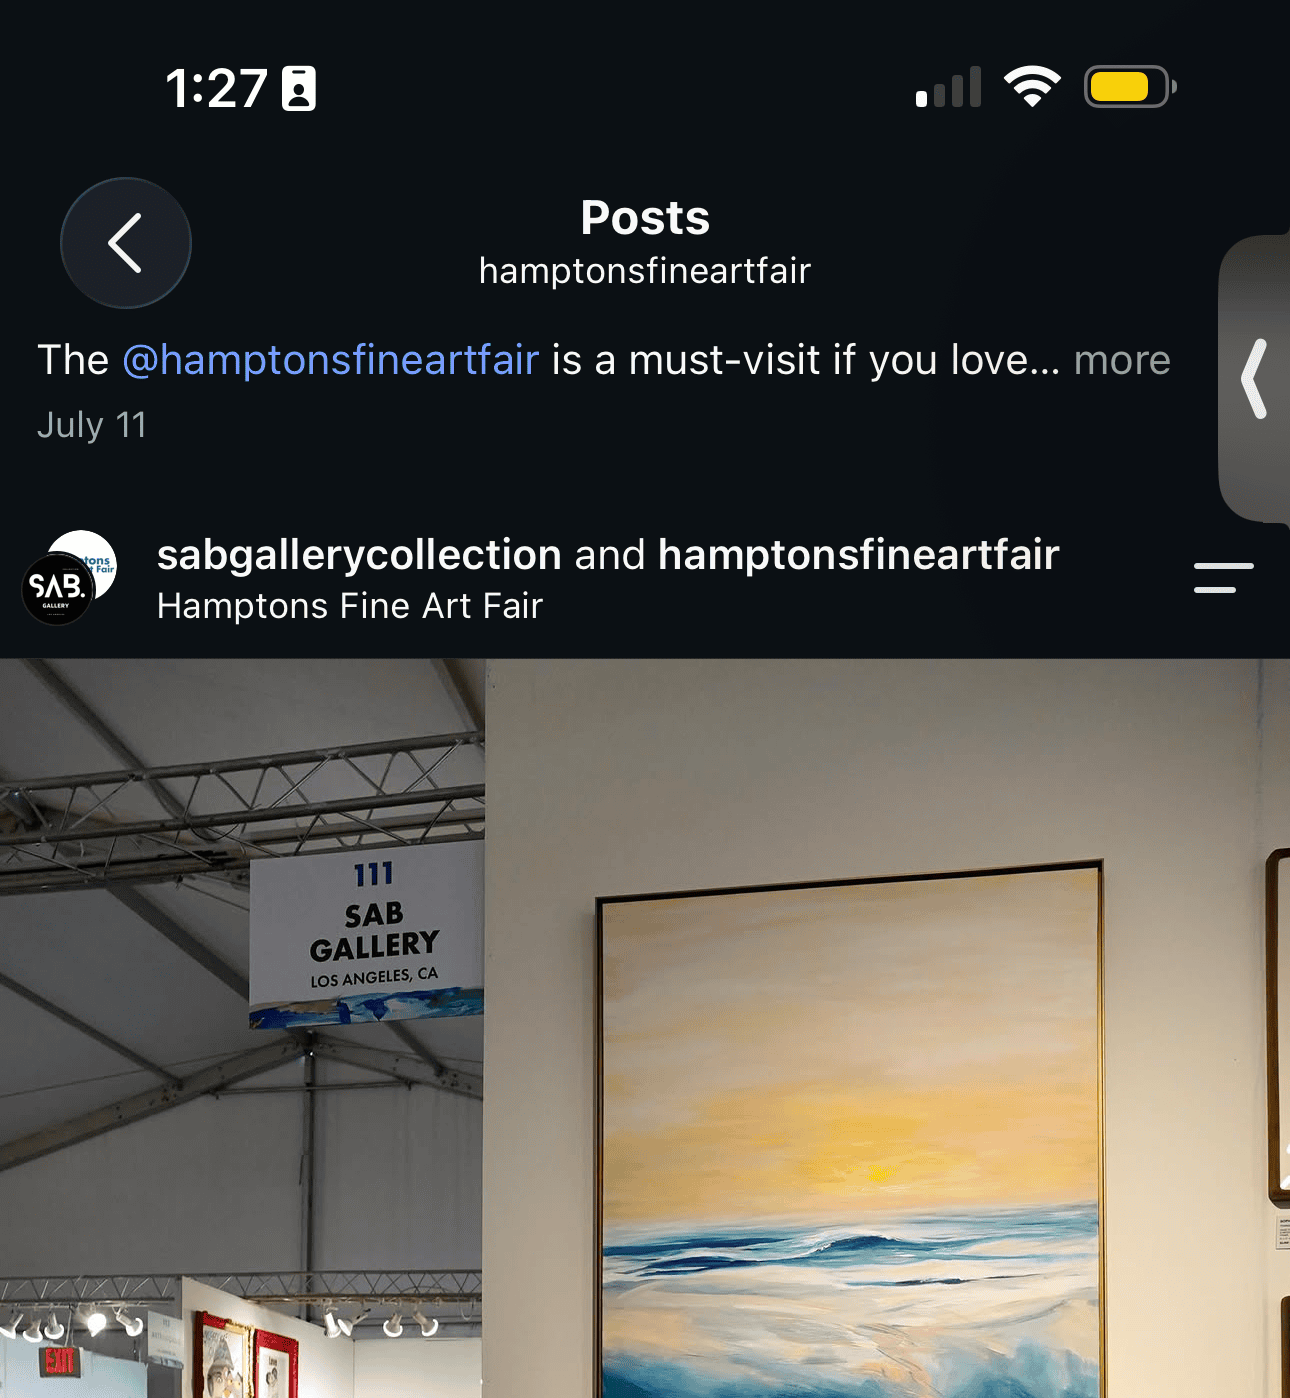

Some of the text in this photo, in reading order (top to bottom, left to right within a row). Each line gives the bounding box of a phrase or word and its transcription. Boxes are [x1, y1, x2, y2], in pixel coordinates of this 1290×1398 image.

[166, 67, 268, 108] 1:27
[582, 199, 710, 236] Posts
[480, 255, 812, 291] hamptonsfineartfair
[37, 342, 109, 376] The
[123, 342, 540, 383] @hamptonsfineartfair
[553, 342, 582, 376] is
[595, 350, 615, 376] a
[630, 342, 821, 376] must-visit
[834, 342, 857, 375] if
[868, 350, 937, 383] you
[1075, 350, 1171, 376] more
[36, 409, 145, 445] July 11
[96, 565, 115, 573] Fair
[157, 536, 1061, 578] sabgallerycollection and hamptonsfineartfair
[158, 590, 544, 626] Hamptons Fine Art Fair
[354, 861, 393, 887] 111
[345, 901, 404, 929] SAB
[309, 929, 441, 963] GALLERY
[311, 966, 439, 988] LOS ANGELES, CA
[45, 1347, 75, 1373] EXIT
